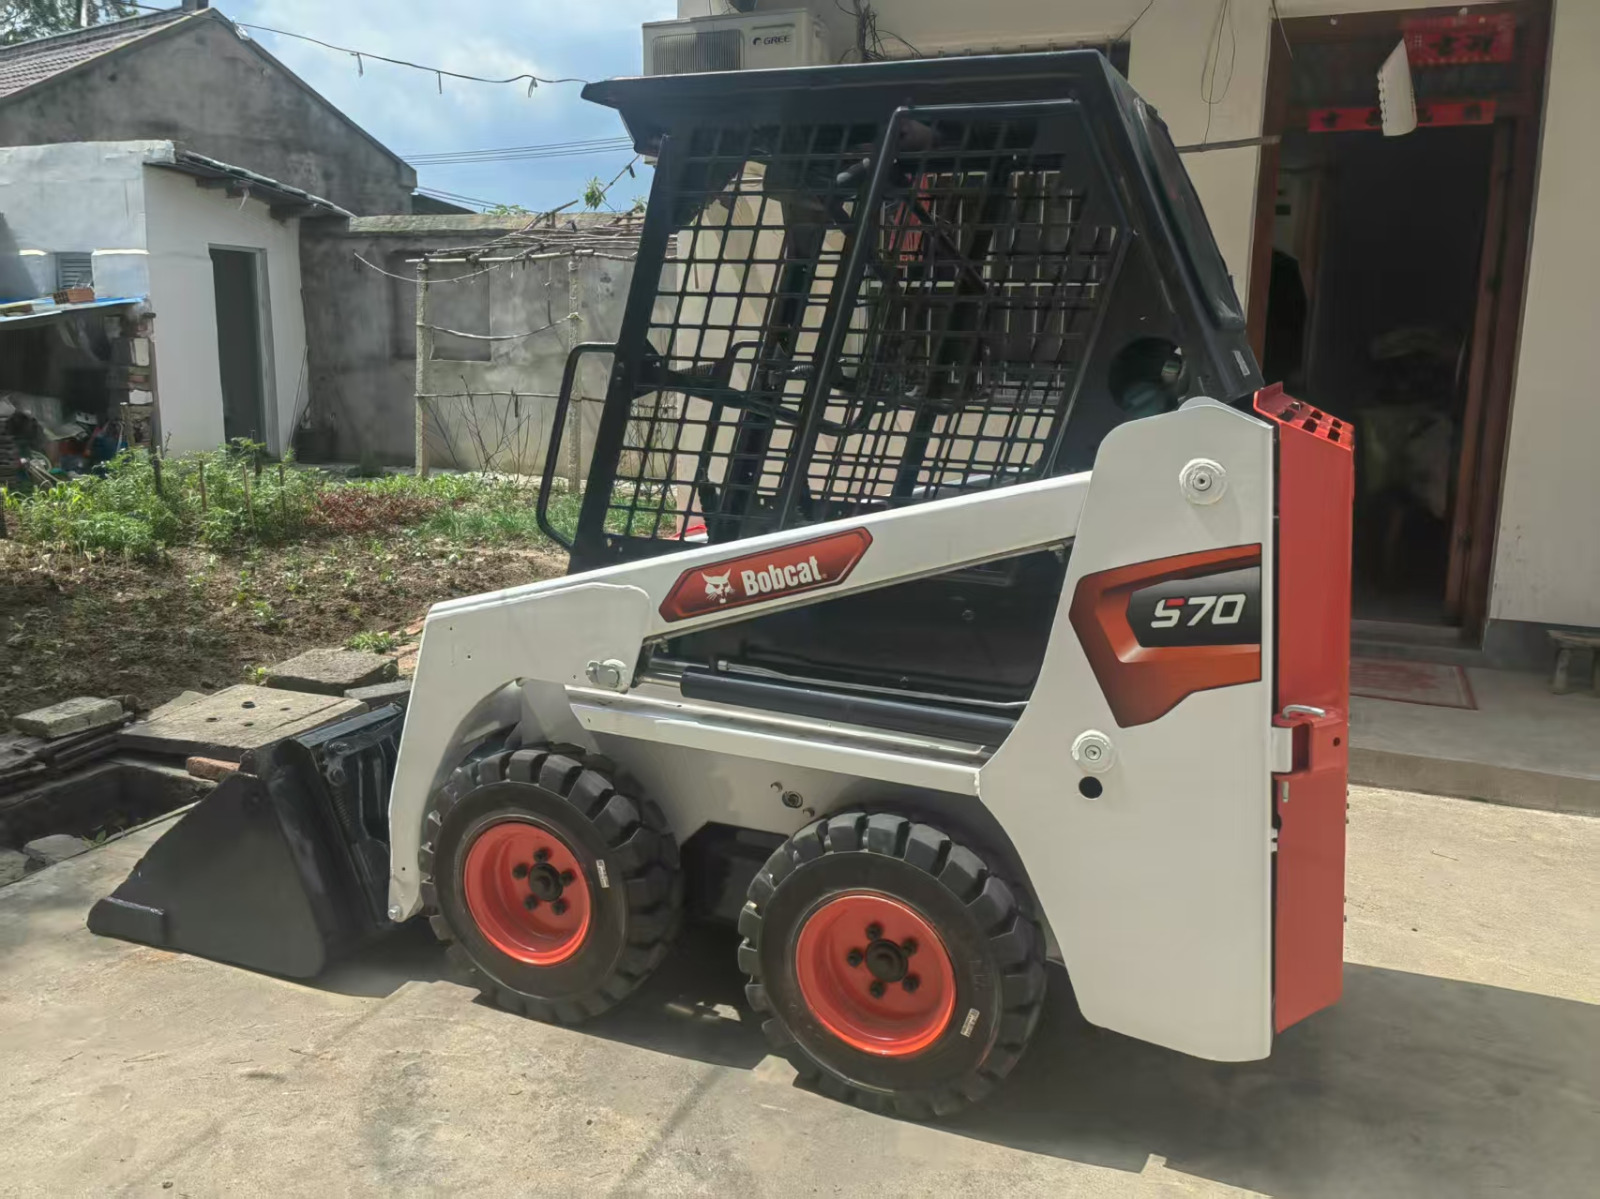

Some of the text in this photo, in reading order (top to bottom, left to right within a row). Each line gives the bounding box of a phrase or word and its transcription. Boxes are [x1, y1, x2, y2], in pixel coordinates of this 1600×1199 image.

[763, 35, 790, 45] GREE
[741, 556, 822, 596] Bobcat
[1150, 593, 1246, 628] S70
